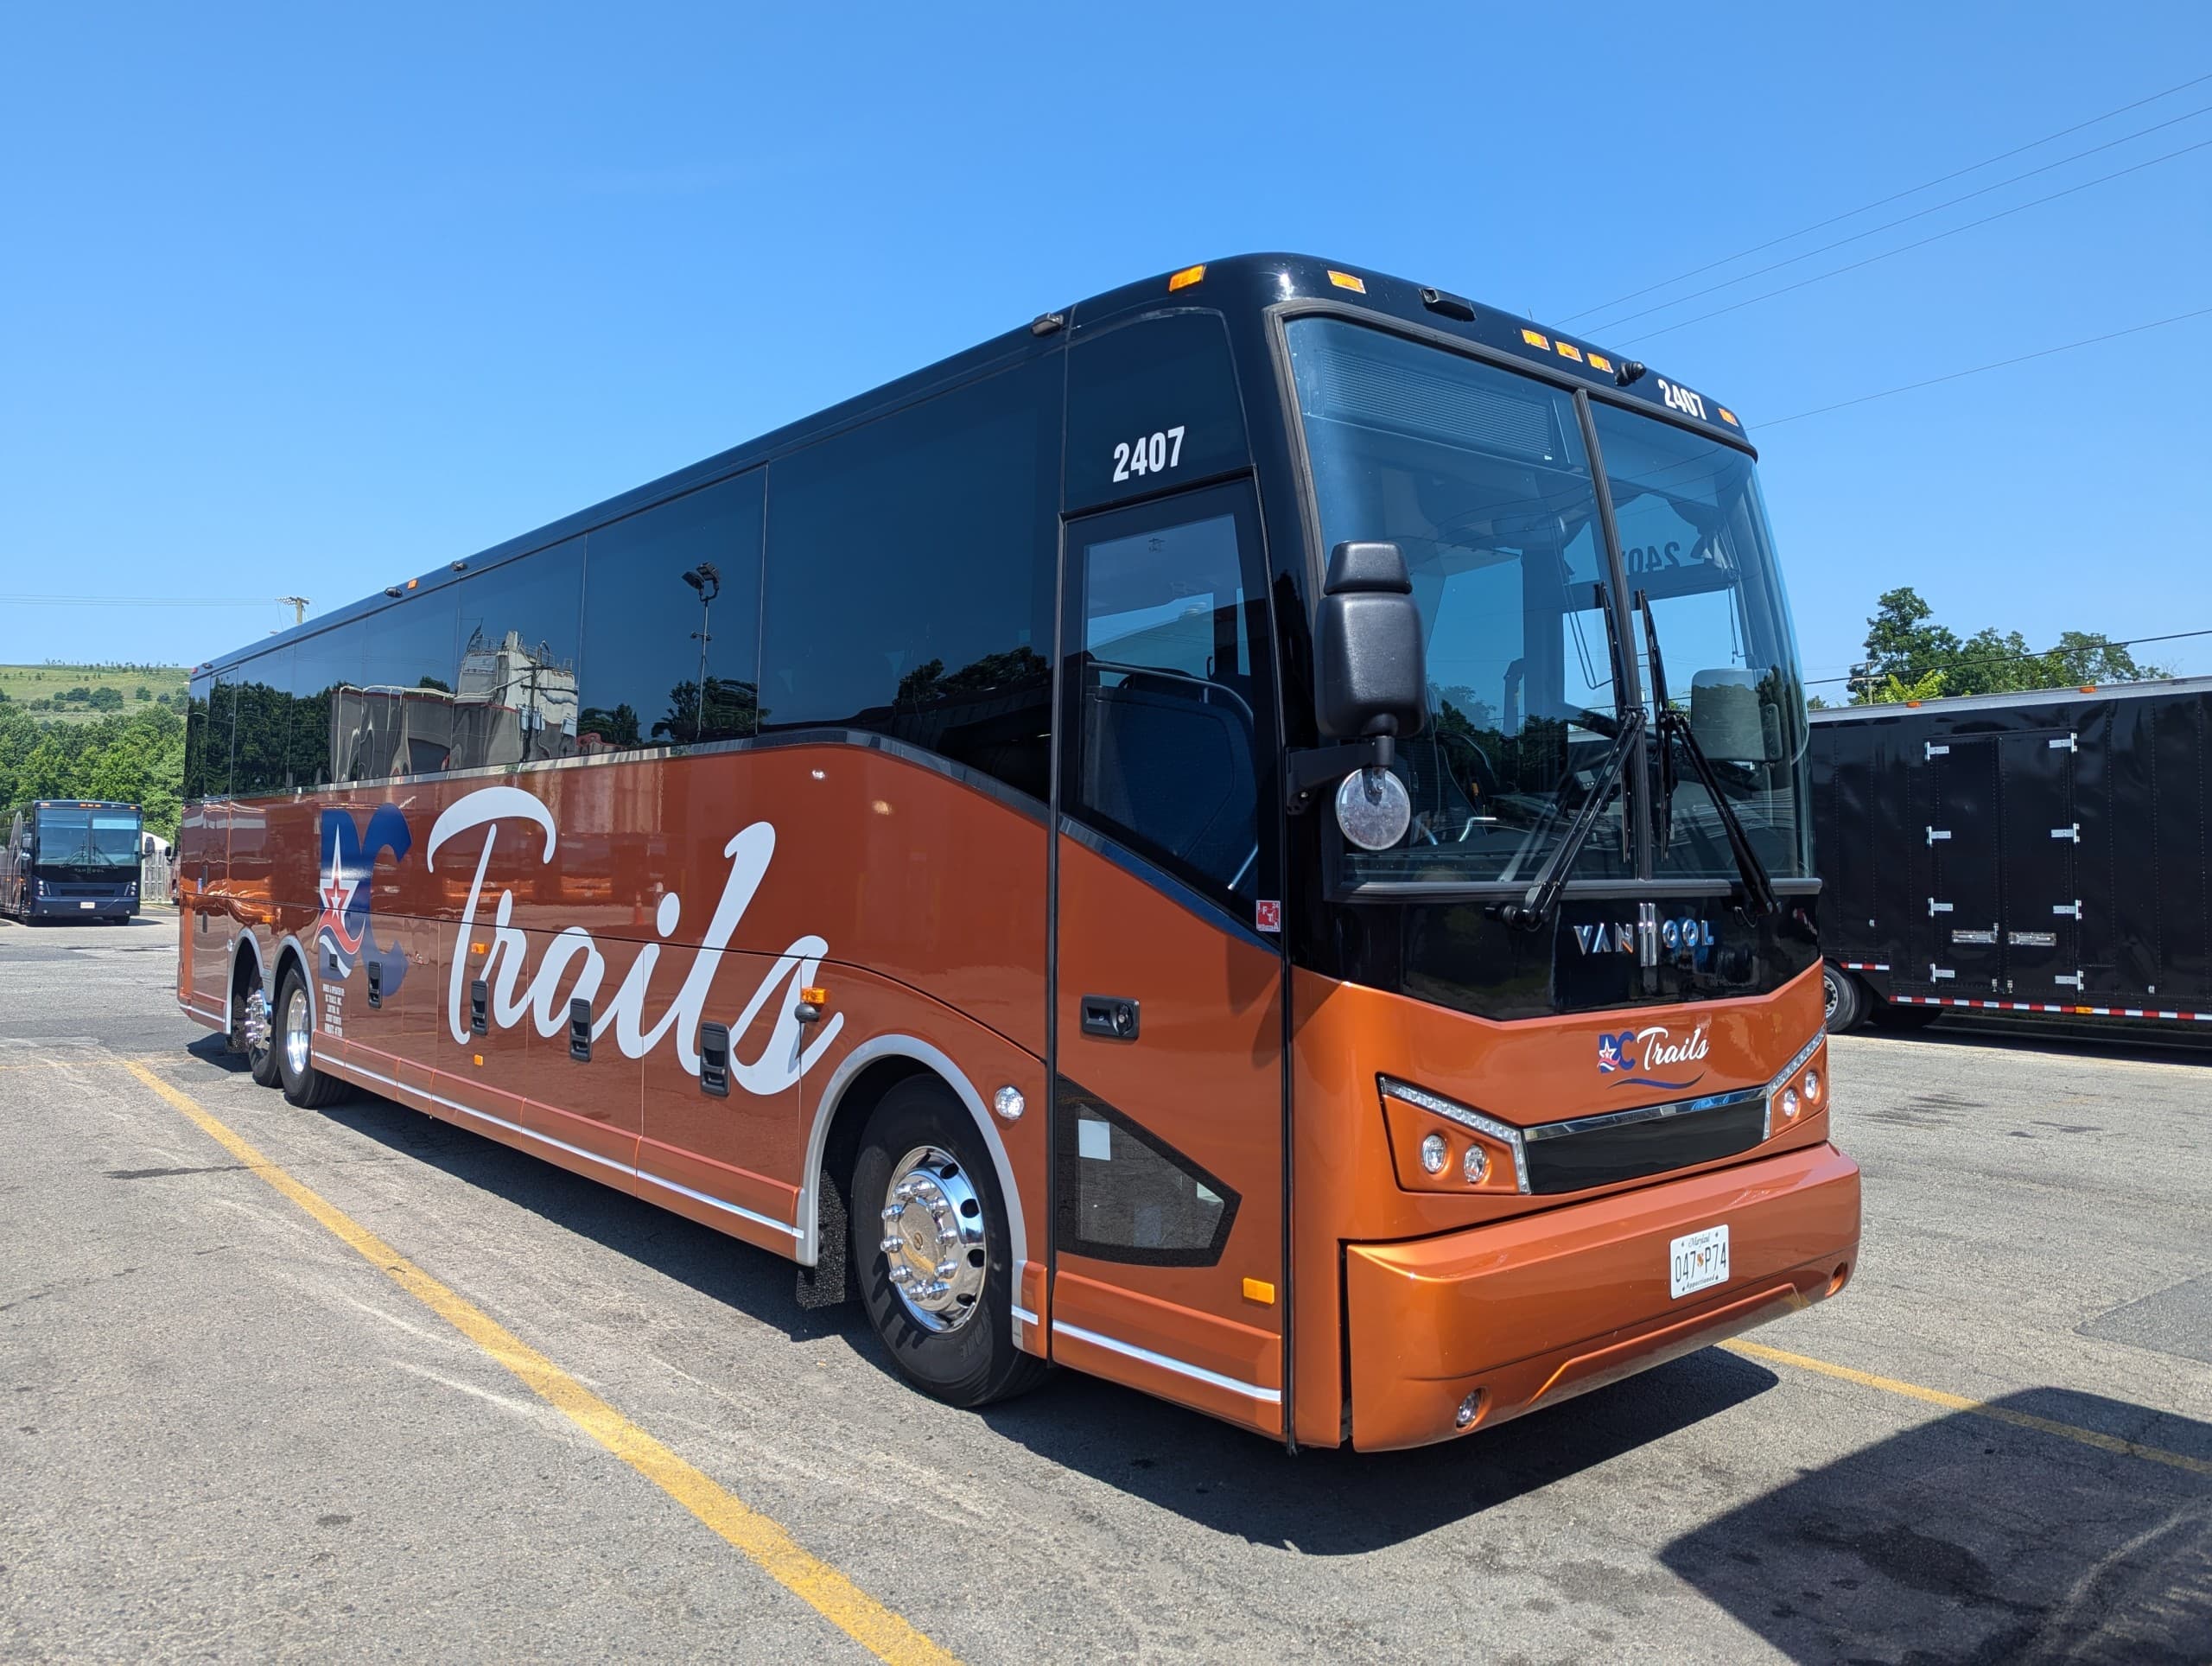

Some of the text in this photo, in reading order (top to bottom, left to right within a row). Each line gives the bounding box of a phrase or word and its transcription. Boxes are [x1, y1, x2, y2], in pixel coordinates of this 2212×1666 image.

[1657, 378, 1707, 421] 2407
[1112, 425, 1185, 483] 2407
[427, 785, 844, 1096] Trails
[1573, 902, 1715, 967] VAN HOOL
[1597, 1026, 1709, 1074] DC Trails
